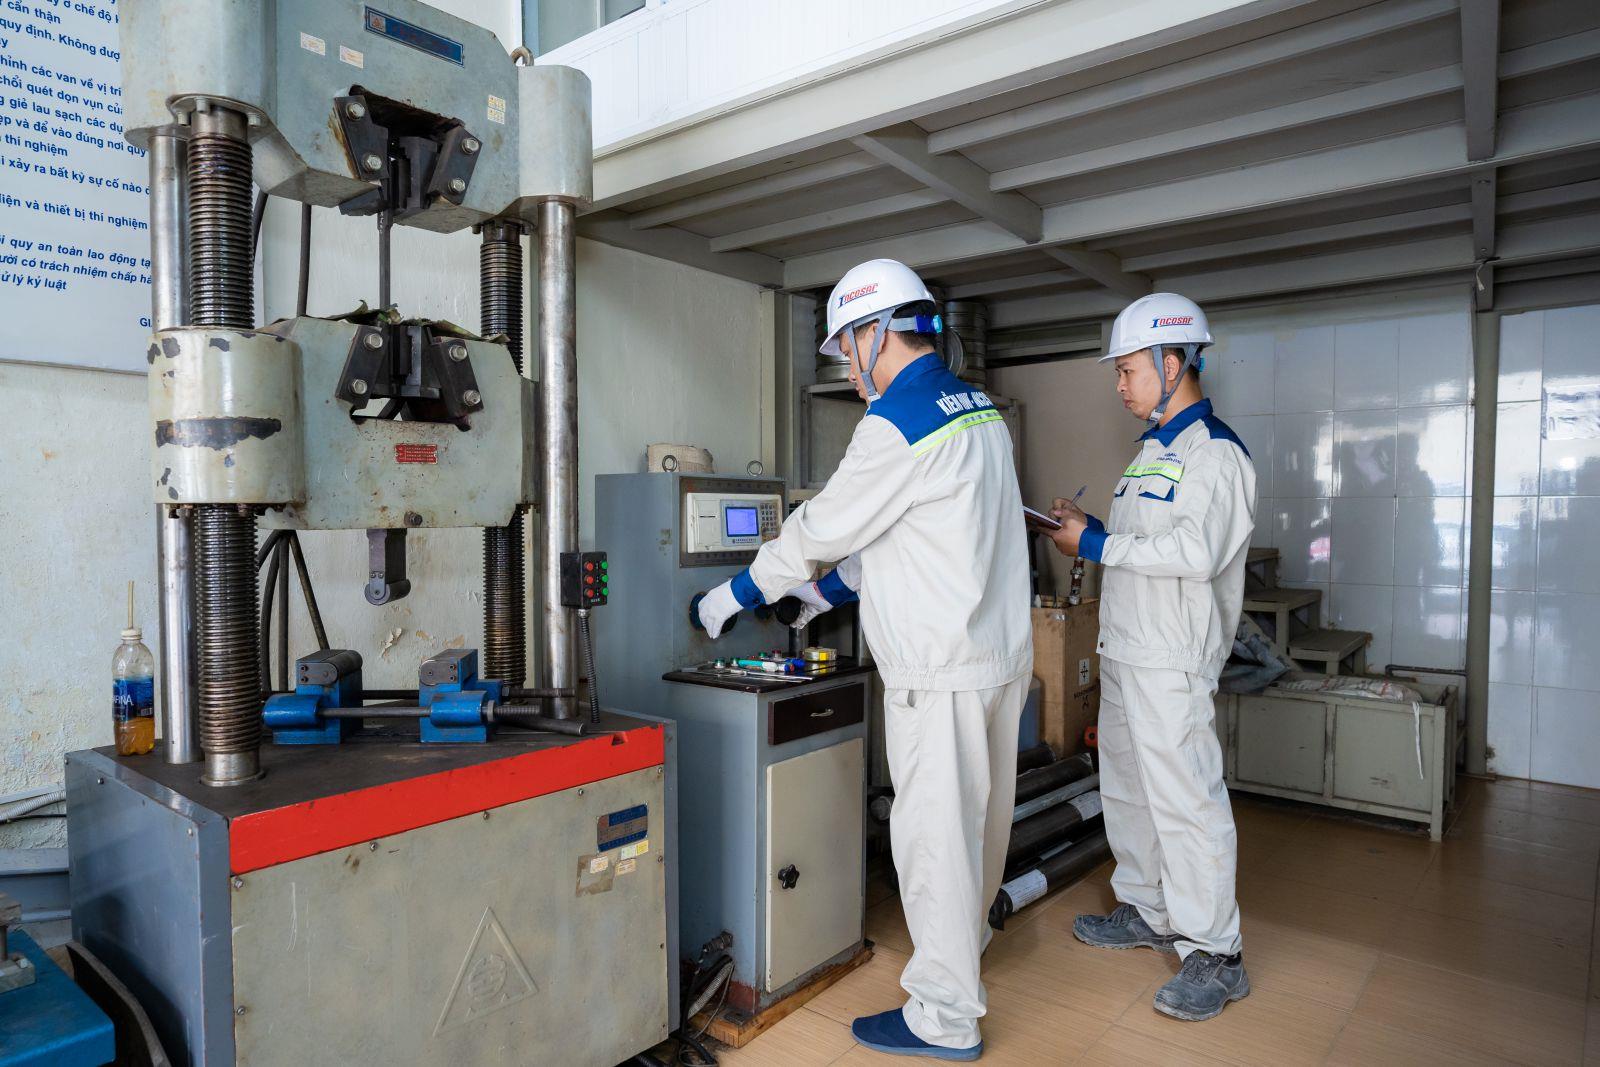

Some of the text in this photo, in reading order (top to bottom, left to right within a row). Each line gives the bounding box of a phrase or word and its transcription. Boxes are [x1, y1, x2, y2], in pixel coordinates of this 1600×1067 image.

[35, 8, 61, 24] thận
[75, 4, 95, 16] chế
[98, 9, 111, 23] độ
[0, 18, 21, 33] quy
[26, 25, 55, 41] định.
[59, 33, 96, 56] Không
[32, 66, 52, 78] các
[56, 72, 77, 84] van
[97, 83, 107, 95] vị
[27, 84, 53, 97] quét
[57, 91, 79, 103] dọn
[83, 97, 103, 110] vụn
[10, 97, 28, 109] giẻ
[33, 101, 50, 115] lau
[55, 110, 82, 123] sạch
[86, 117, 106, 128] các
[15, 118, 30, 129] và
[33, 120, 48, 133] để
[51, 126, 72, 139] vào
[76, 131, 104, 148] đúng
[107, 140, 124, 151] nơi
[25, 140, 68, 157] nghiệm
[9, 157, 31, 173] xảy
[35, 164, 46, 174] ra
[50, 166, 69, 179] bất
[88, 176, 103, 188] sự
[105, 177, 120, 189] cố
[122, 182, 142, 193] nào
[25, 199, 40, 211] và
[44, 202, 71, 217] thiết
[74, 207, 85, 221] bị
[108, 215, 148, 231] nghiệm
[10, 238, 34, 251] quy
[38, 243, 52, 252] an
[58, 244, 83, 257] toàn
[88, 248, 105, 260] lao
[13, 273, 25, 286] lý
[44, 277, 67, 292] luật
[21, 257, 37, 268] có
[40, 260, 70, 273] trách
[73, 263, 108, 279] nhiệm
[110, 270, 137, 284] chấp
